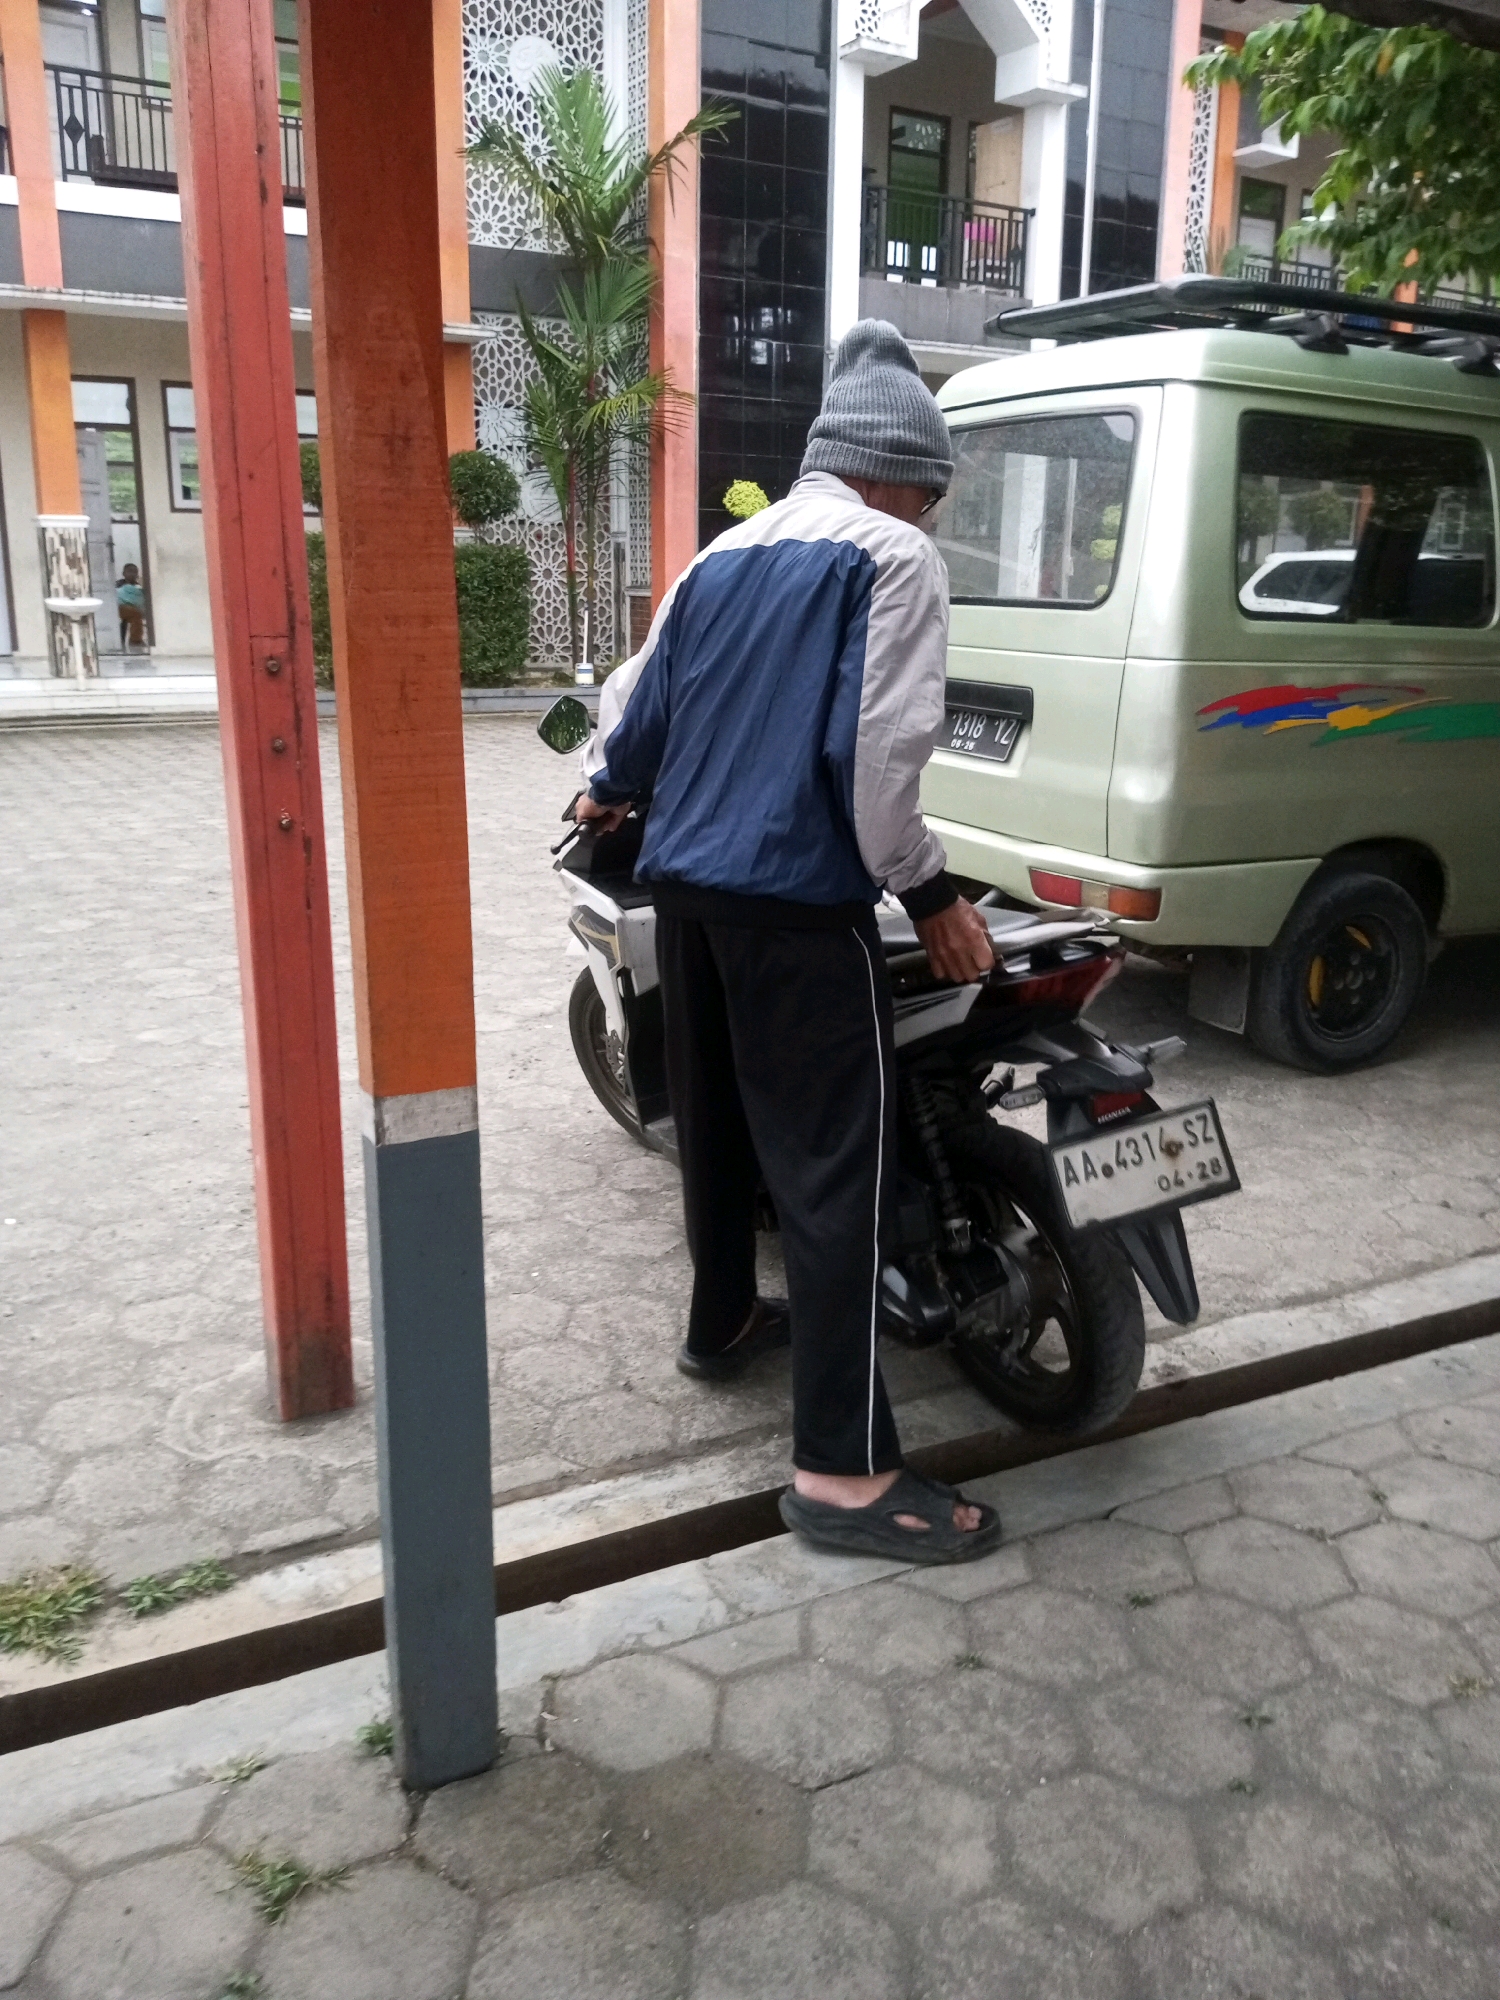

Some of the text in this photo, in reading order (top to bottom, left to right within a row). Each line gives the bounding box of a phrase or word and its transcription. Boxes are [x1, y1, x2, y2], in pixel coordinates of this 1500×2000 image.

[952, 711, 1017, 745] 1318 YZ
[1097, 1106, 1131, 1124] HONDA
[1063, 1150, 1098, 1188] AA
[1183, 1113, 1215, 1148] SZ
